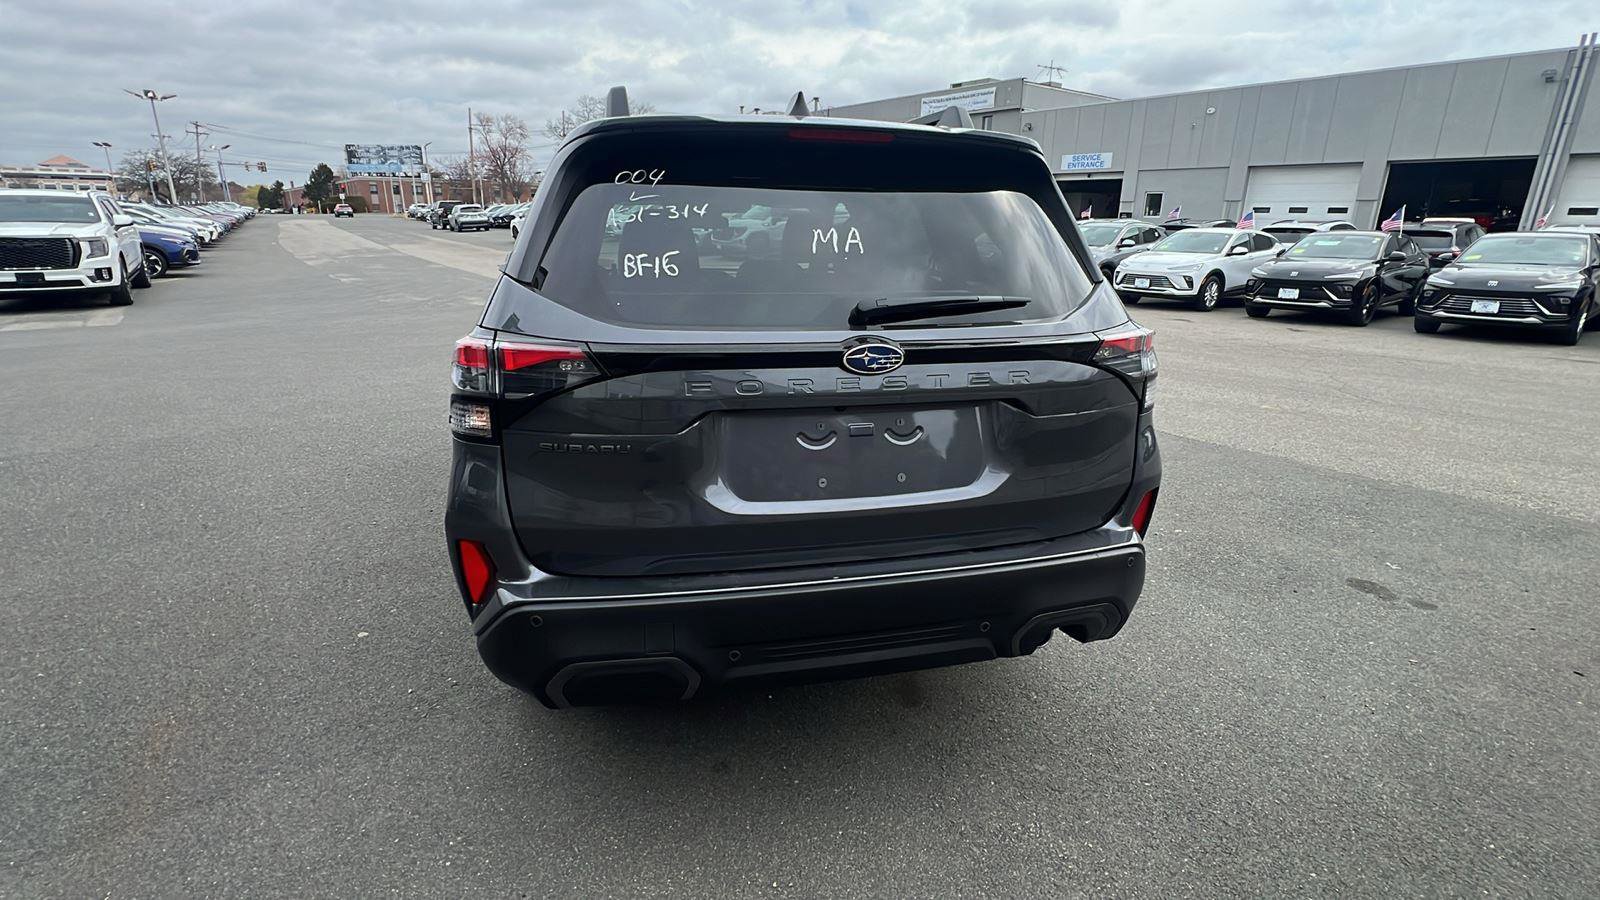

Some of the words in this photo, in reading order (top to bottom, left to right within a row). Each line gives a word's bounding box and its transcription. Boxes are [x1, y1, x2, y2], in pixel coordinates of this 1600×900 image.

[1067, 161, 1105, 169] ENTRANCE
[1072, 154, 1101, 162] SERVICE
[614, 168, 666, 188] 004
[812, 226, 864, 254] MA
[684, 370, 1033, 397] FORESTER
[539, 442, 632, 455] SUBARU
